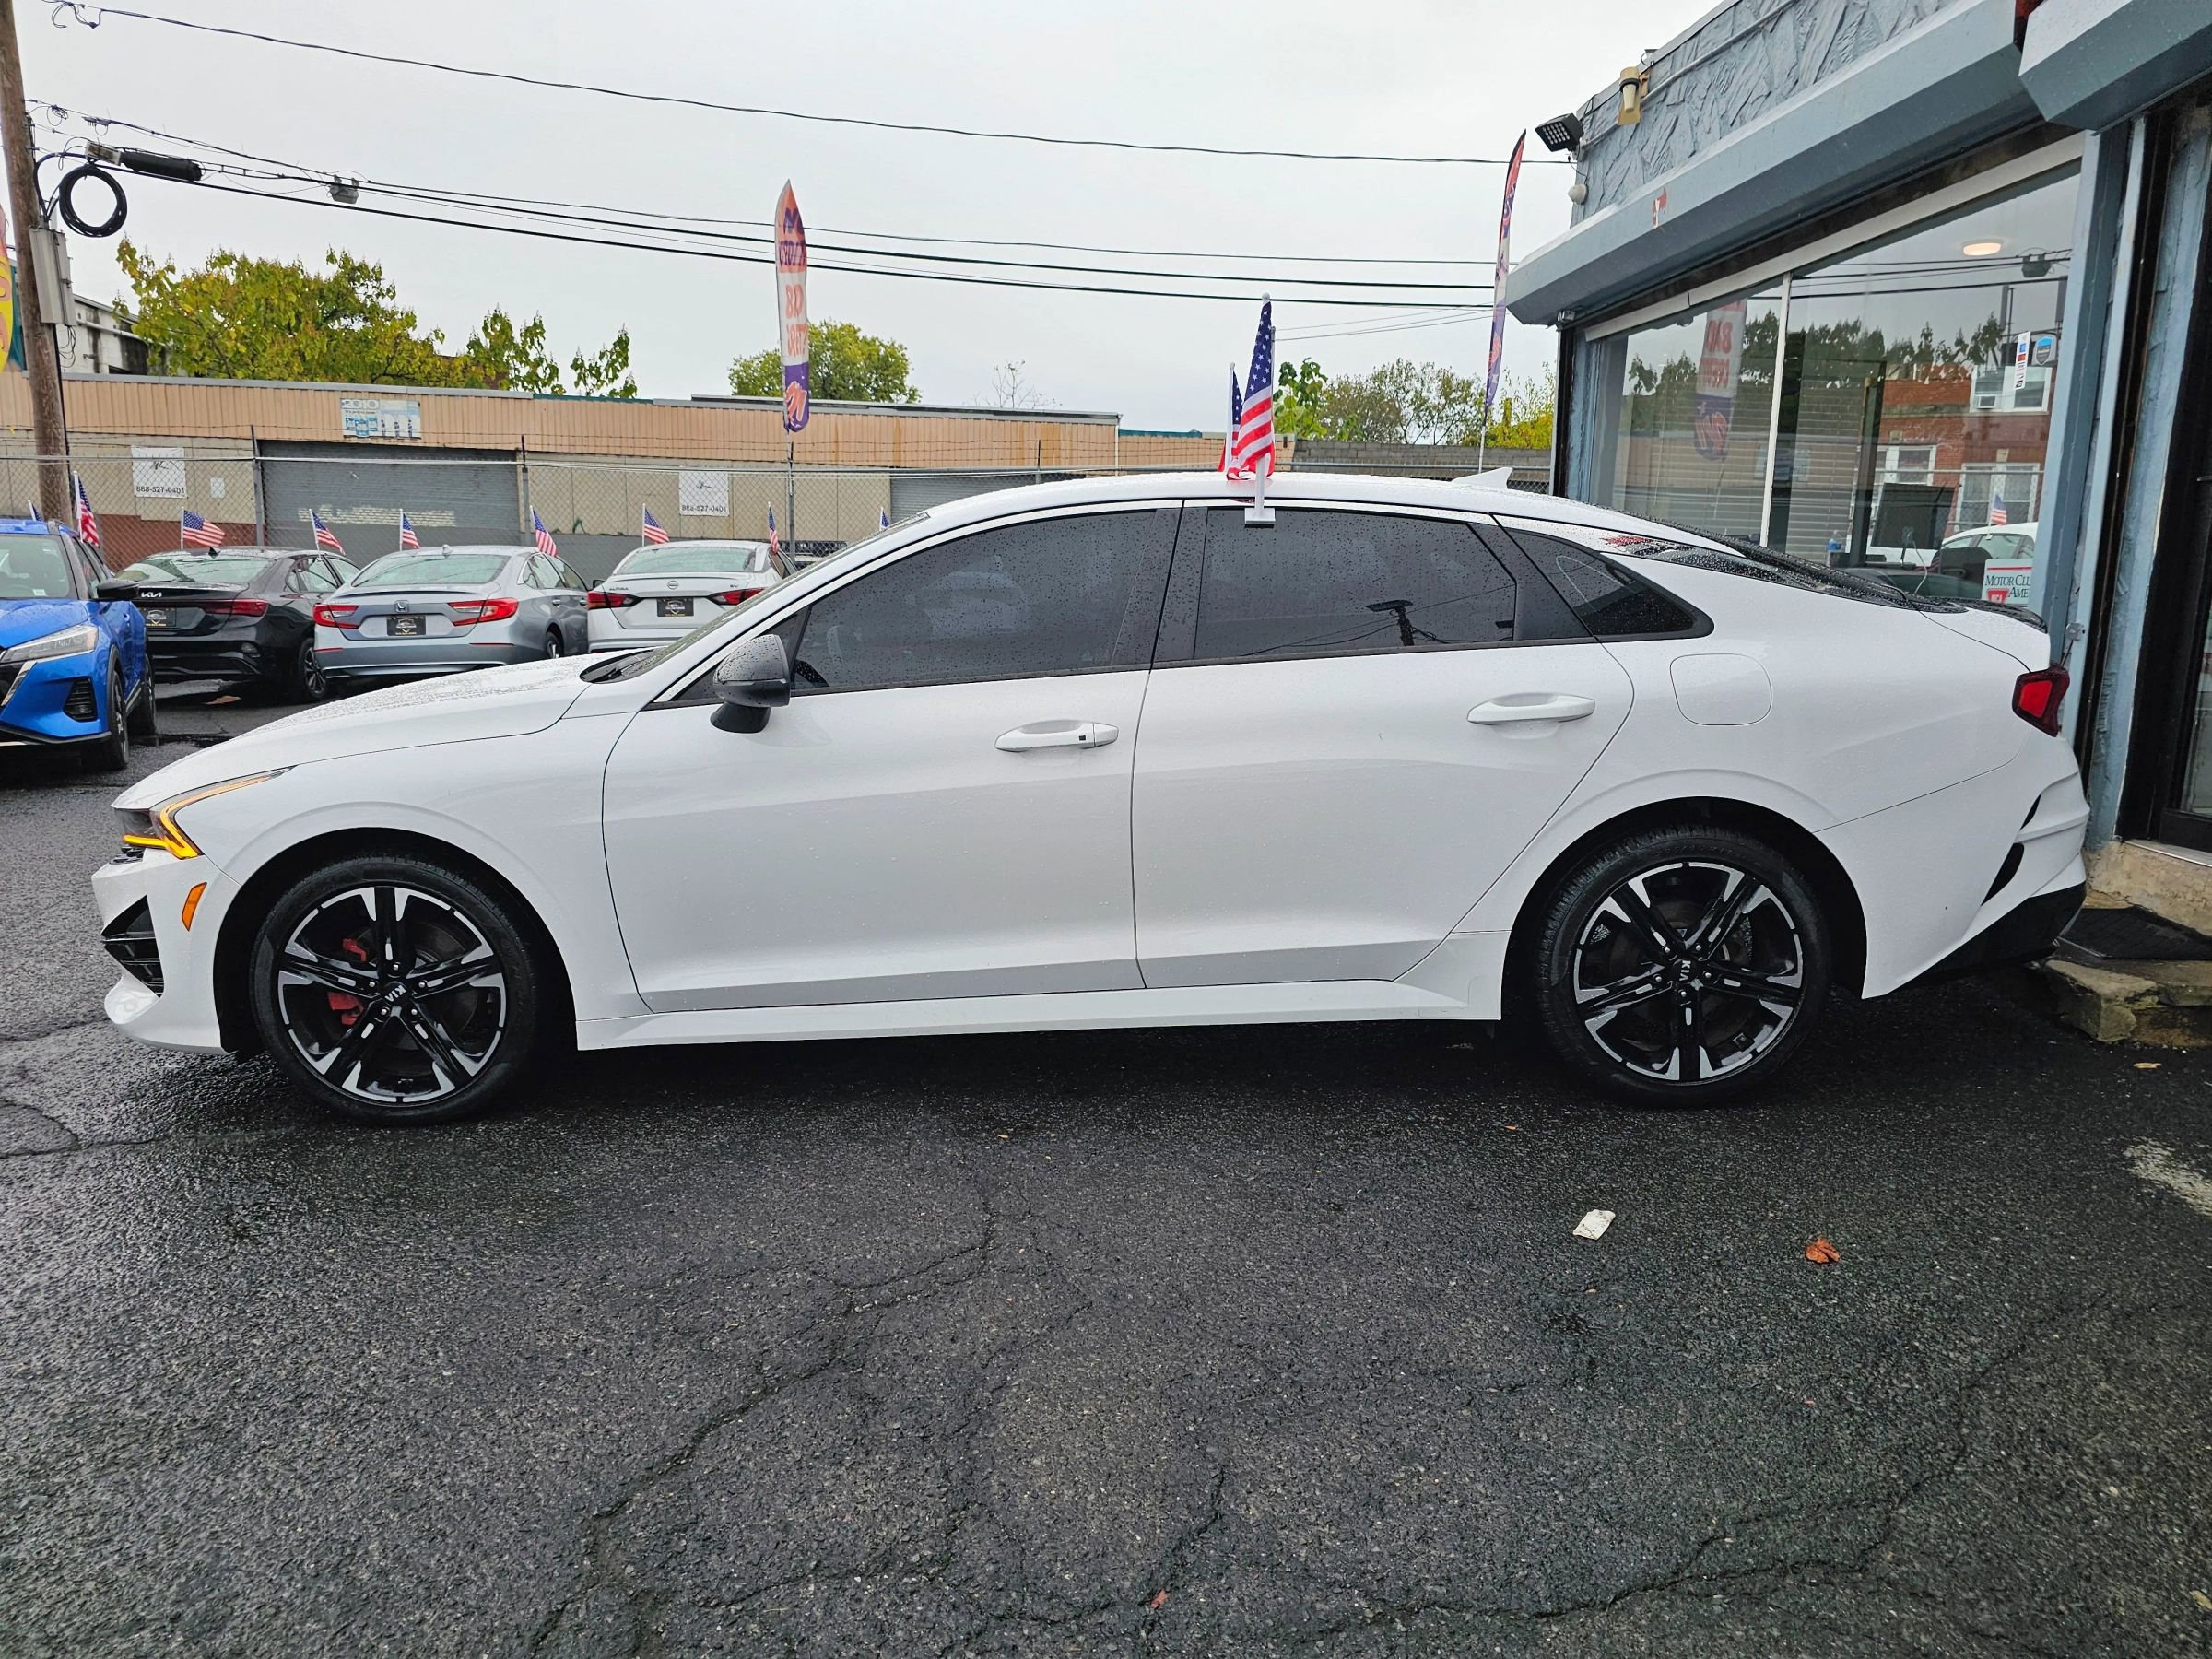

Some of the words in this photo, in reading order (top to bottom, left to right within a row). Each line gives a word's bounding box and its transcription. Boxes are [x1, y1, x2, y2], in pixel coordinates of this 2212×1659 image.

[785, 283, 805, 319] BD
[1985, 575, 2014, 586] MOTOR
[1678, 959, 1691, 981] KIA
[384, 984, 406, 1002] KIA
